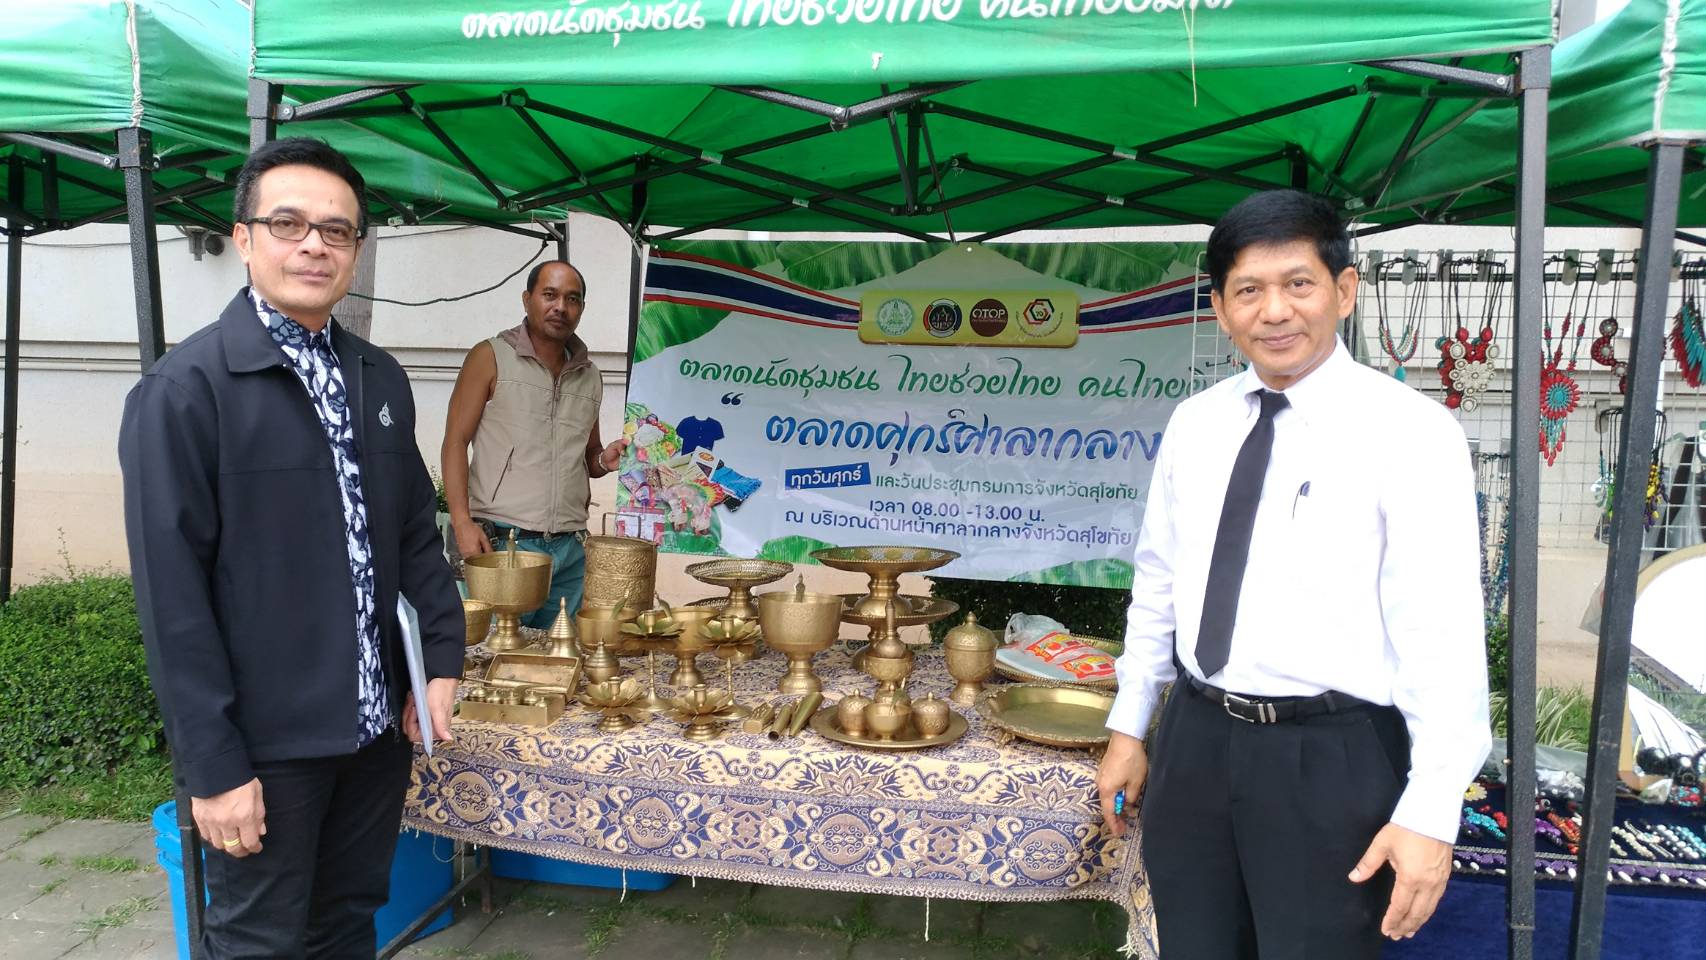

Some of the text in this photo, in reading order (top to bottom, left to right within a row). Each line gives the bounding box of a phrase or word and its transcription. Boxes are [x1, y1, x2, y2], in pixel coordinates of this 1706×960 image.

[971, 308, 1006, 319] OTOP
[679, 358, 880, 398] ตลาดนัดชุมชน
[888, 354, 1062, 396] ไทยช่วยไทย
[765, 408, 1162, 467] ตลาดศุกร์ศาลากลาง
[790, 465, 1138, 503] ทุกวันศุกร์ และวันประชุมกรมการจังหวัดสุโขทัย
[785, 510, 1132, 549] ณ บริเวณด้านหน้าศาลากลางจังหวัดสุโขทัย
[869, 500, 905, 514] เวลา
[912, 501, 960, 517] 08.00
[1029, 509, 1046, 522] น.
